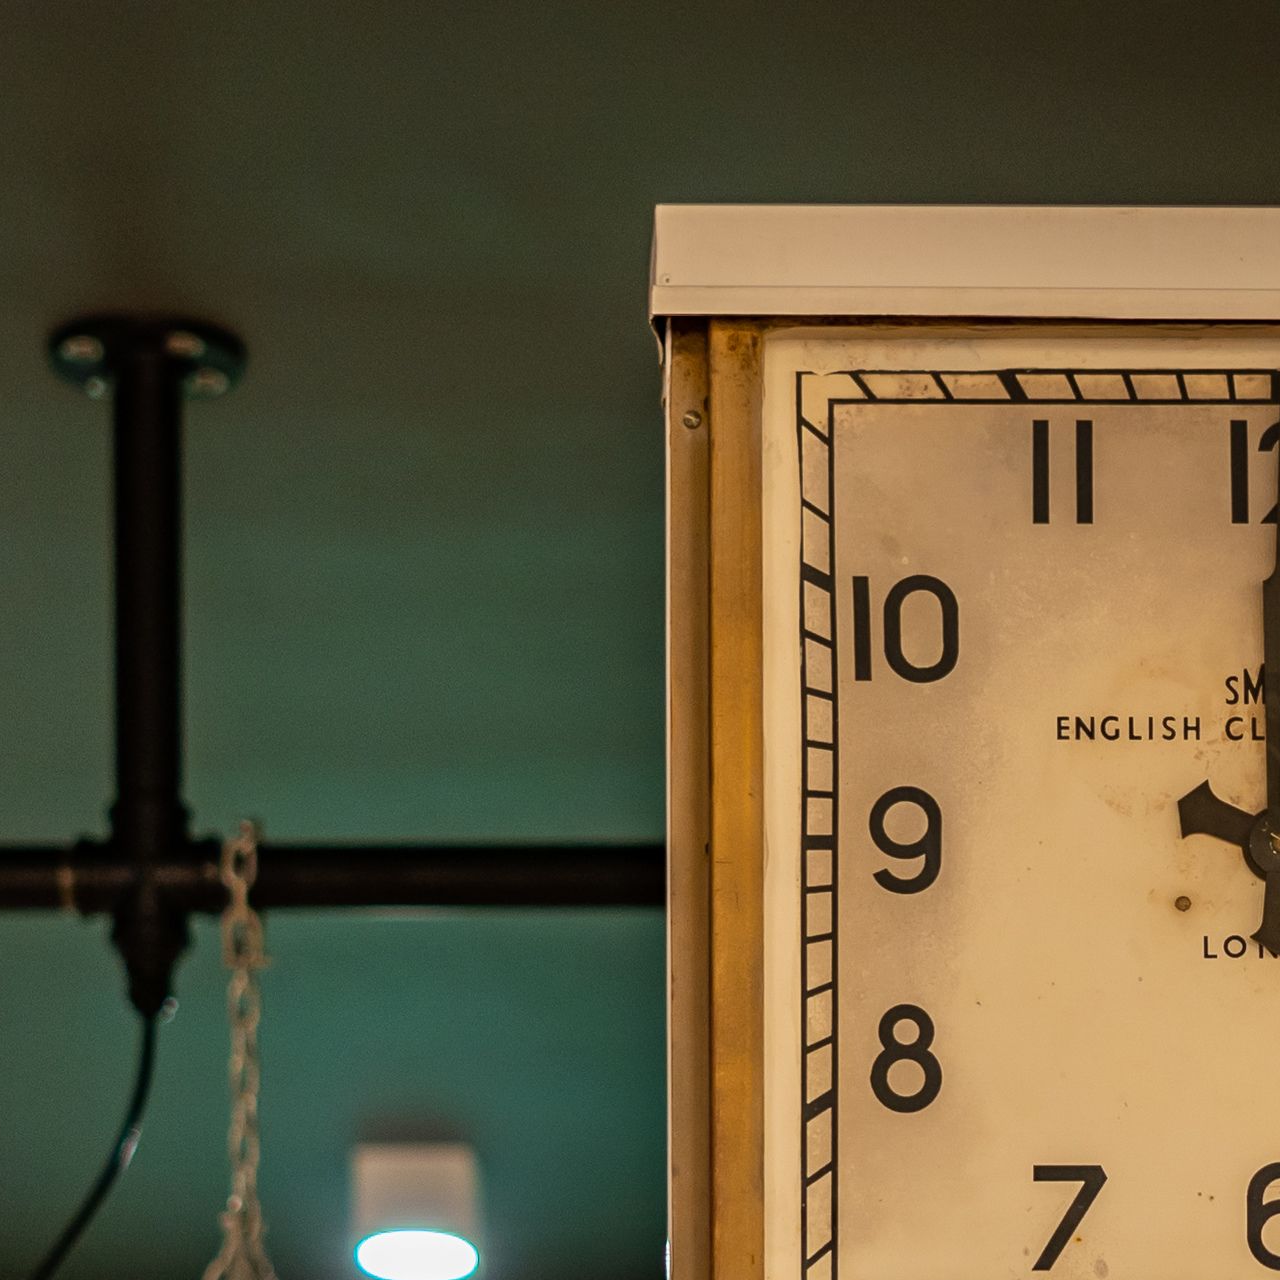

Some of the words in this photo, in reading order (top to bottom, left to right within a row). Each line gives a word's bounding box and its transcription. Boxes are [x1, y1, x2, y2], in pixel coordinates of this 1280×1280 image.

[1032, 419, 1094, 525] 11
[852, 574, 959, 684] 10
[1056, 715, 1201, 741] ENGLISH
[868, 785, 943, 895] 9
[869, 1003, 943, 1114] 8
[1031, 1164, 1108, 1272] 7
